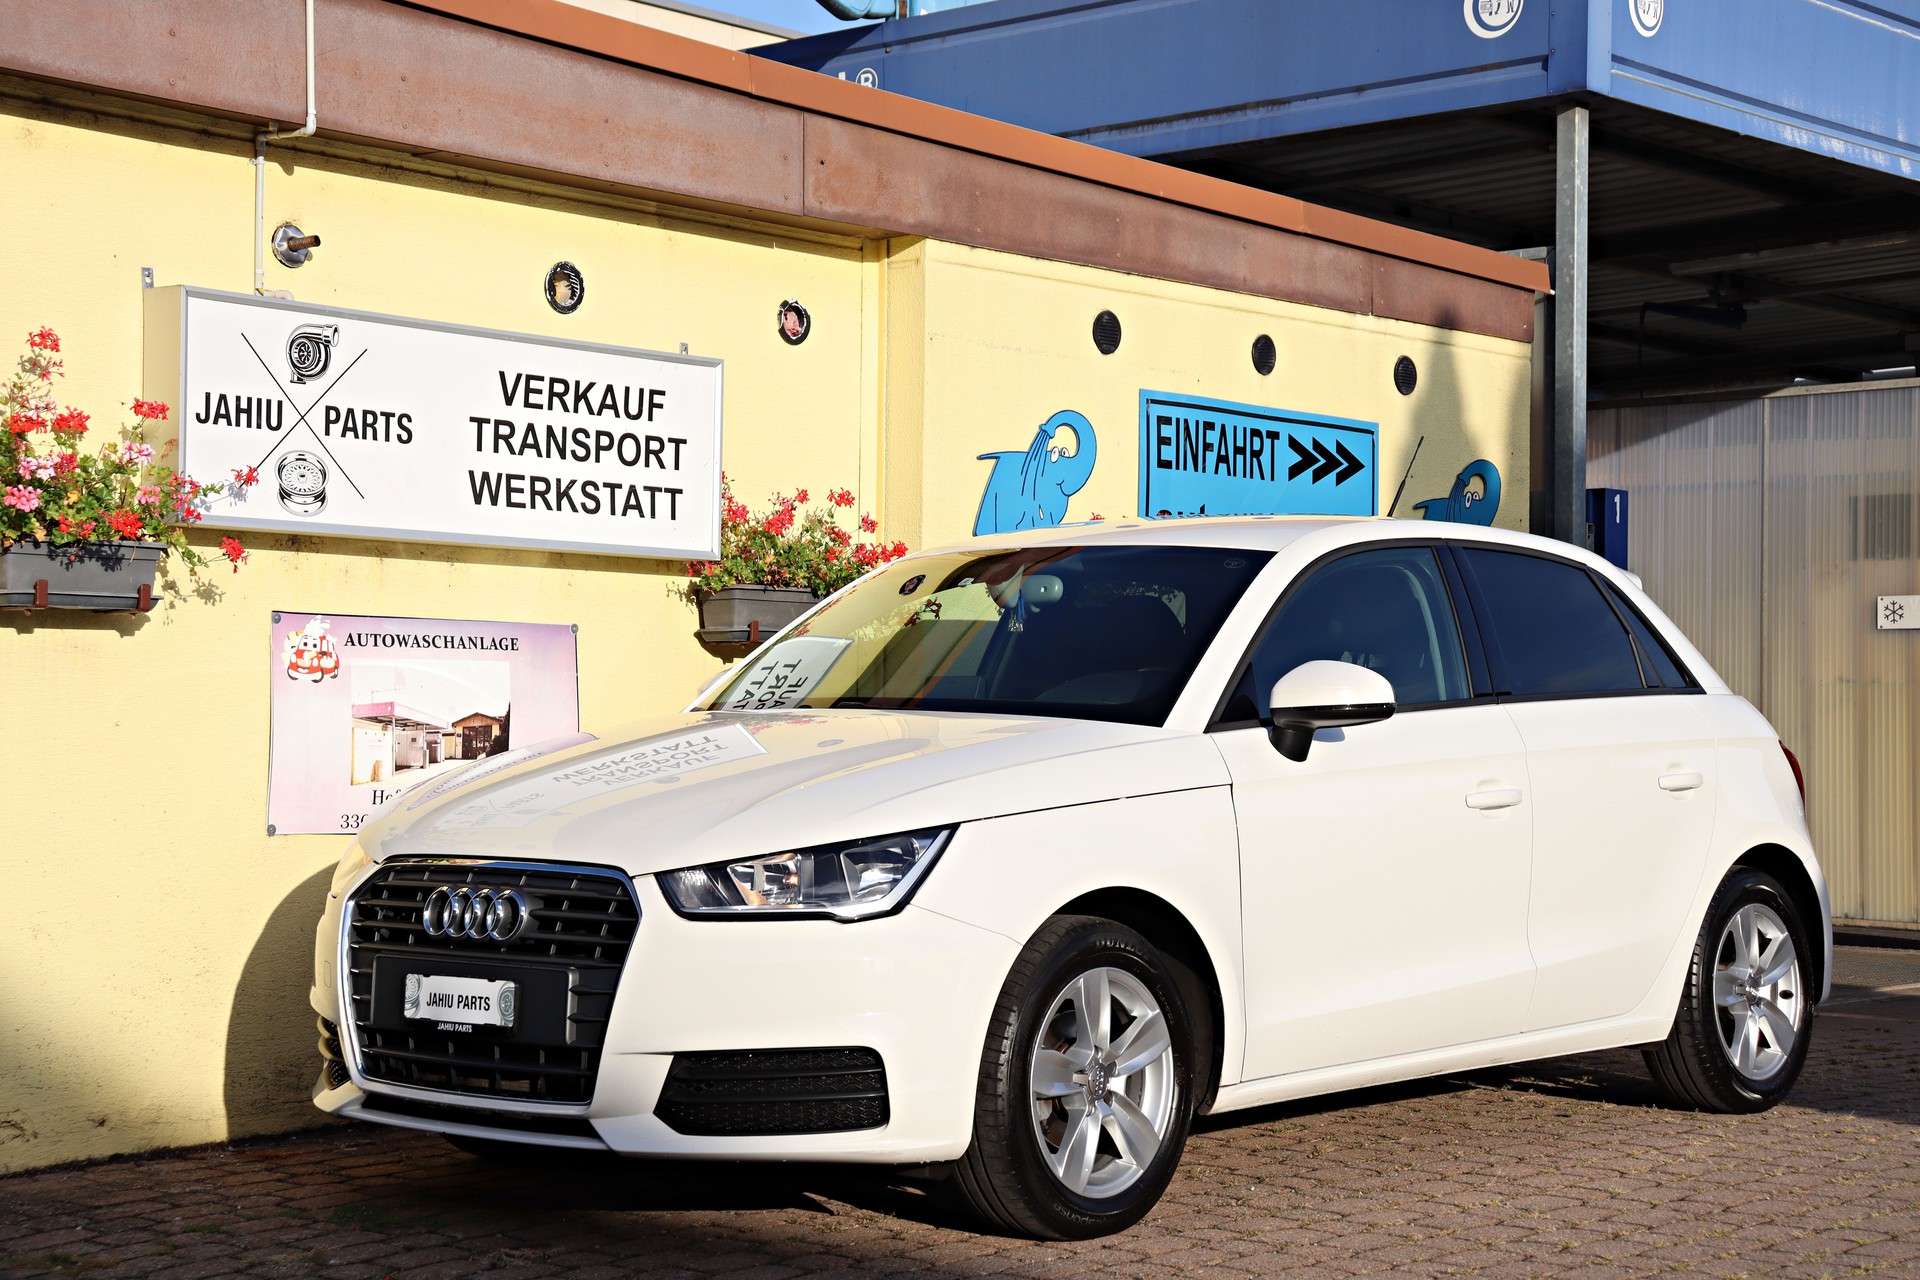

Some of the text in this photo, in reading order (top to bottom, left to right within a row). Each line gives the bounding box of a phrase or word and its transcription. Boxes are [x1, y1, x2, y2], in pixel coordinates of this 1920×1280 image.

[195, 391, 413, 445] JAHIU PARTS
[498, 370, 666, 423] VERKAUF
[469, 416, 688, 471] TRANSPORT
[1156, 415, 1280, 482] EINFAHRT
[468, 469, 684, 521] WERKSTATT
[1613, 493, 1622, 524] 1
[344, 632, 519, 651] AUTOWASCHANLAGE
[426, 992, 491, 1012] JAHIU PARTS
[437, 1022, 473, 1033] JAHIU PARTS
